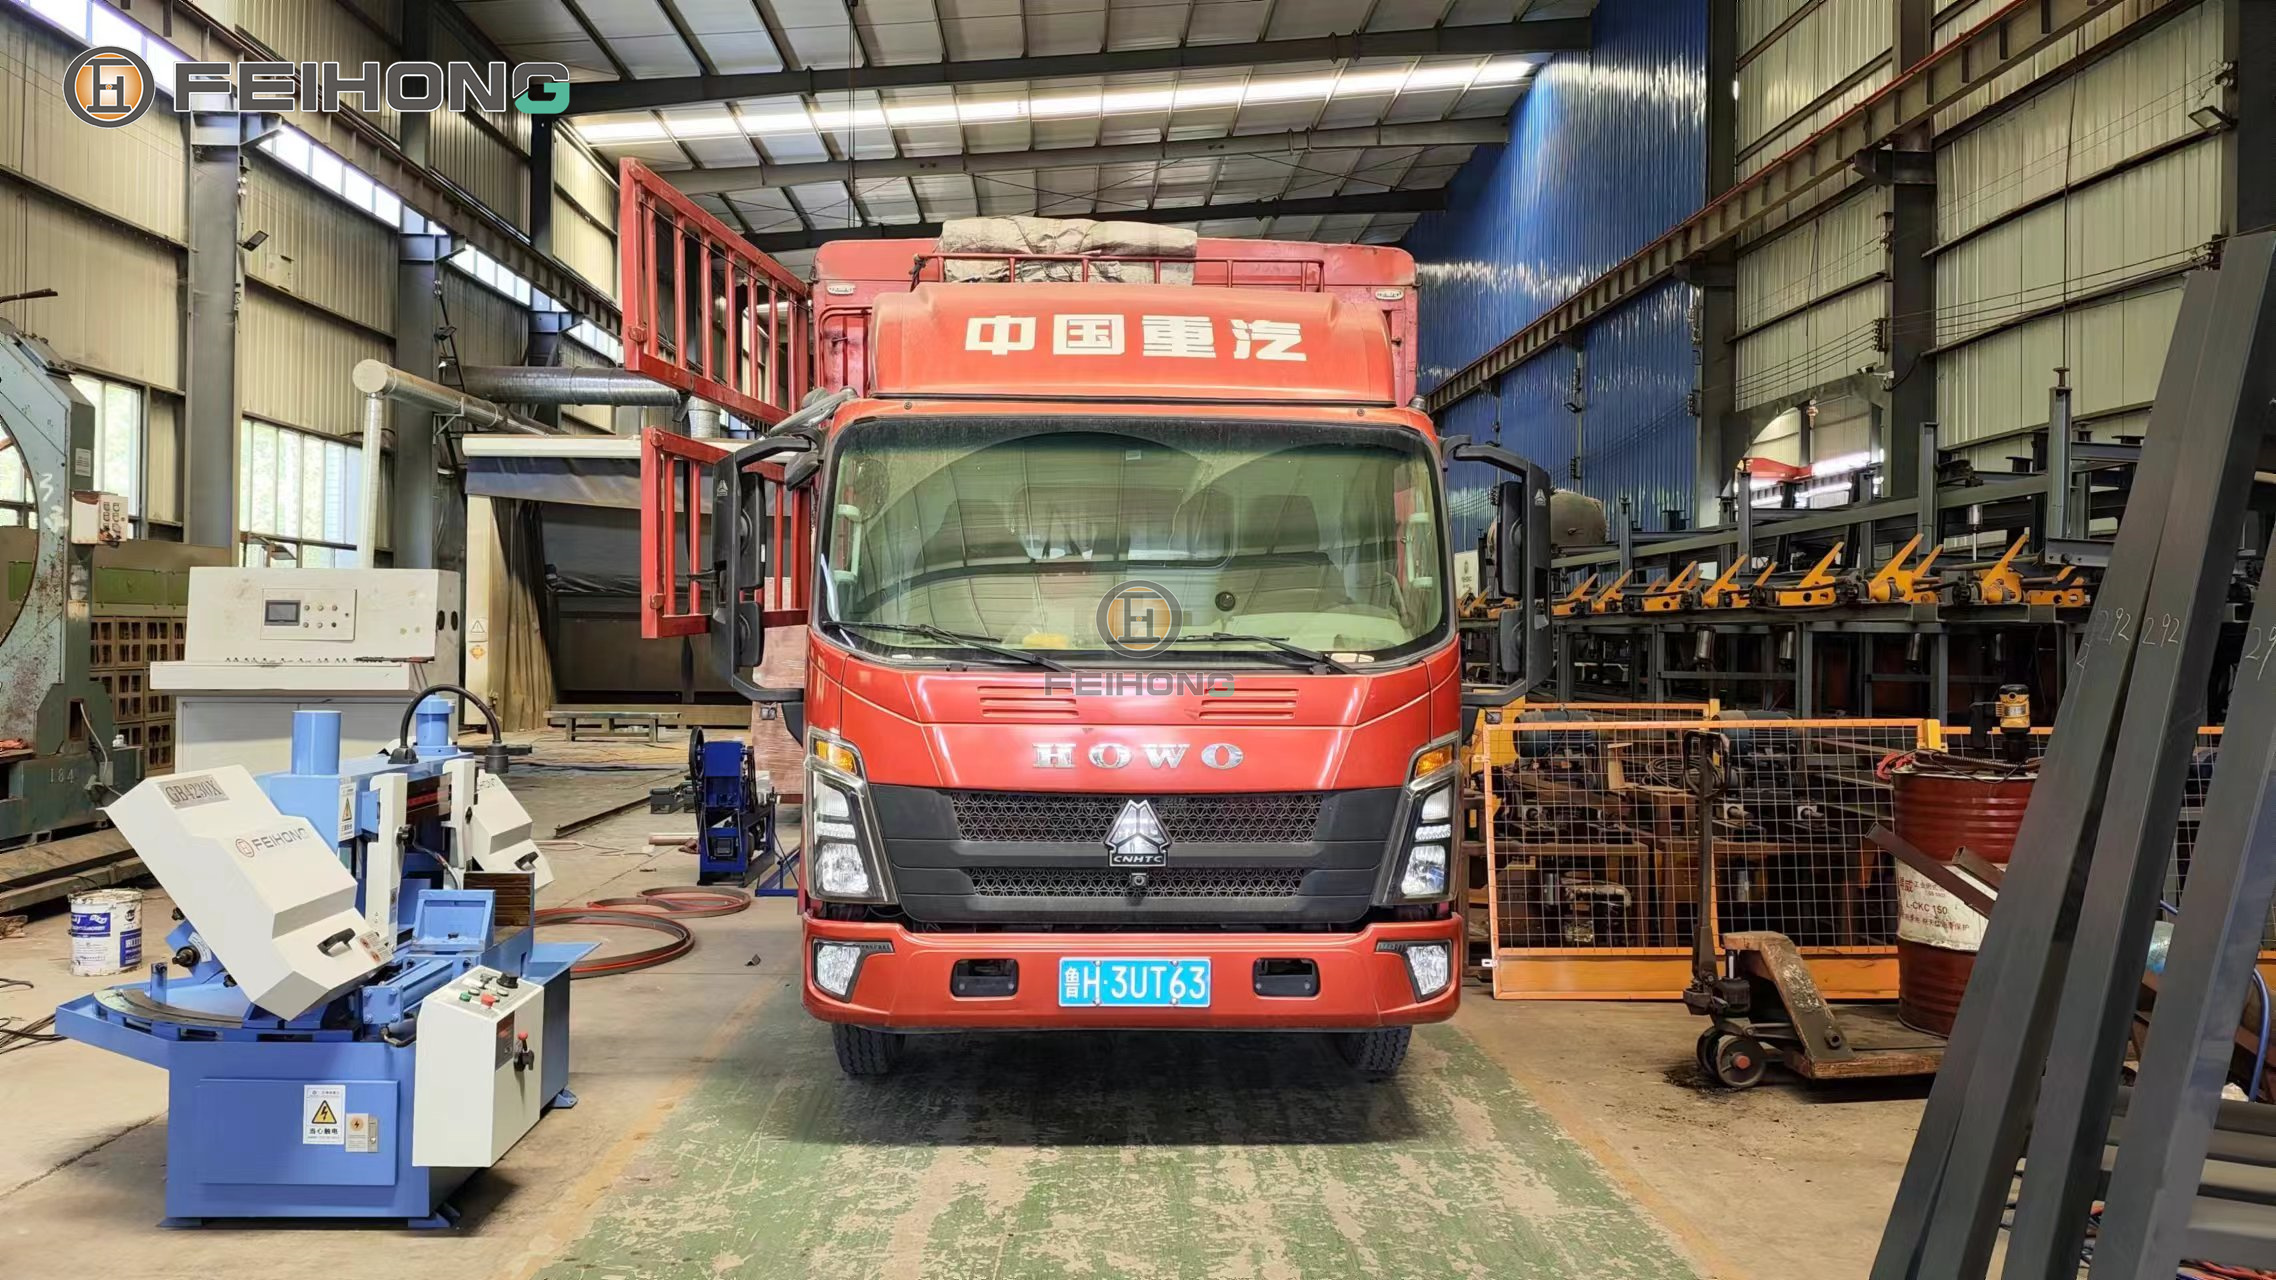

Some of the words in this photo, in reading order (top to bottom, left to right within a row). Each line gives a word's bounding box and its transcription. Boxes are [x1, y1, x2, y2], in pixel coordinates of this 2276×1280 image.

[964, 314, 1307, 362] 中国重汽
[2142, 613, 2181, 648] 292
[1032, 742, 1244, 769] HOWO
[50, 768, 75, 783] 184
[165, 779, 223, 803] GB4230X
[1113, 855, 1163, 863] CNHTC
[1906, 901, 1930, 912] L-CKC
